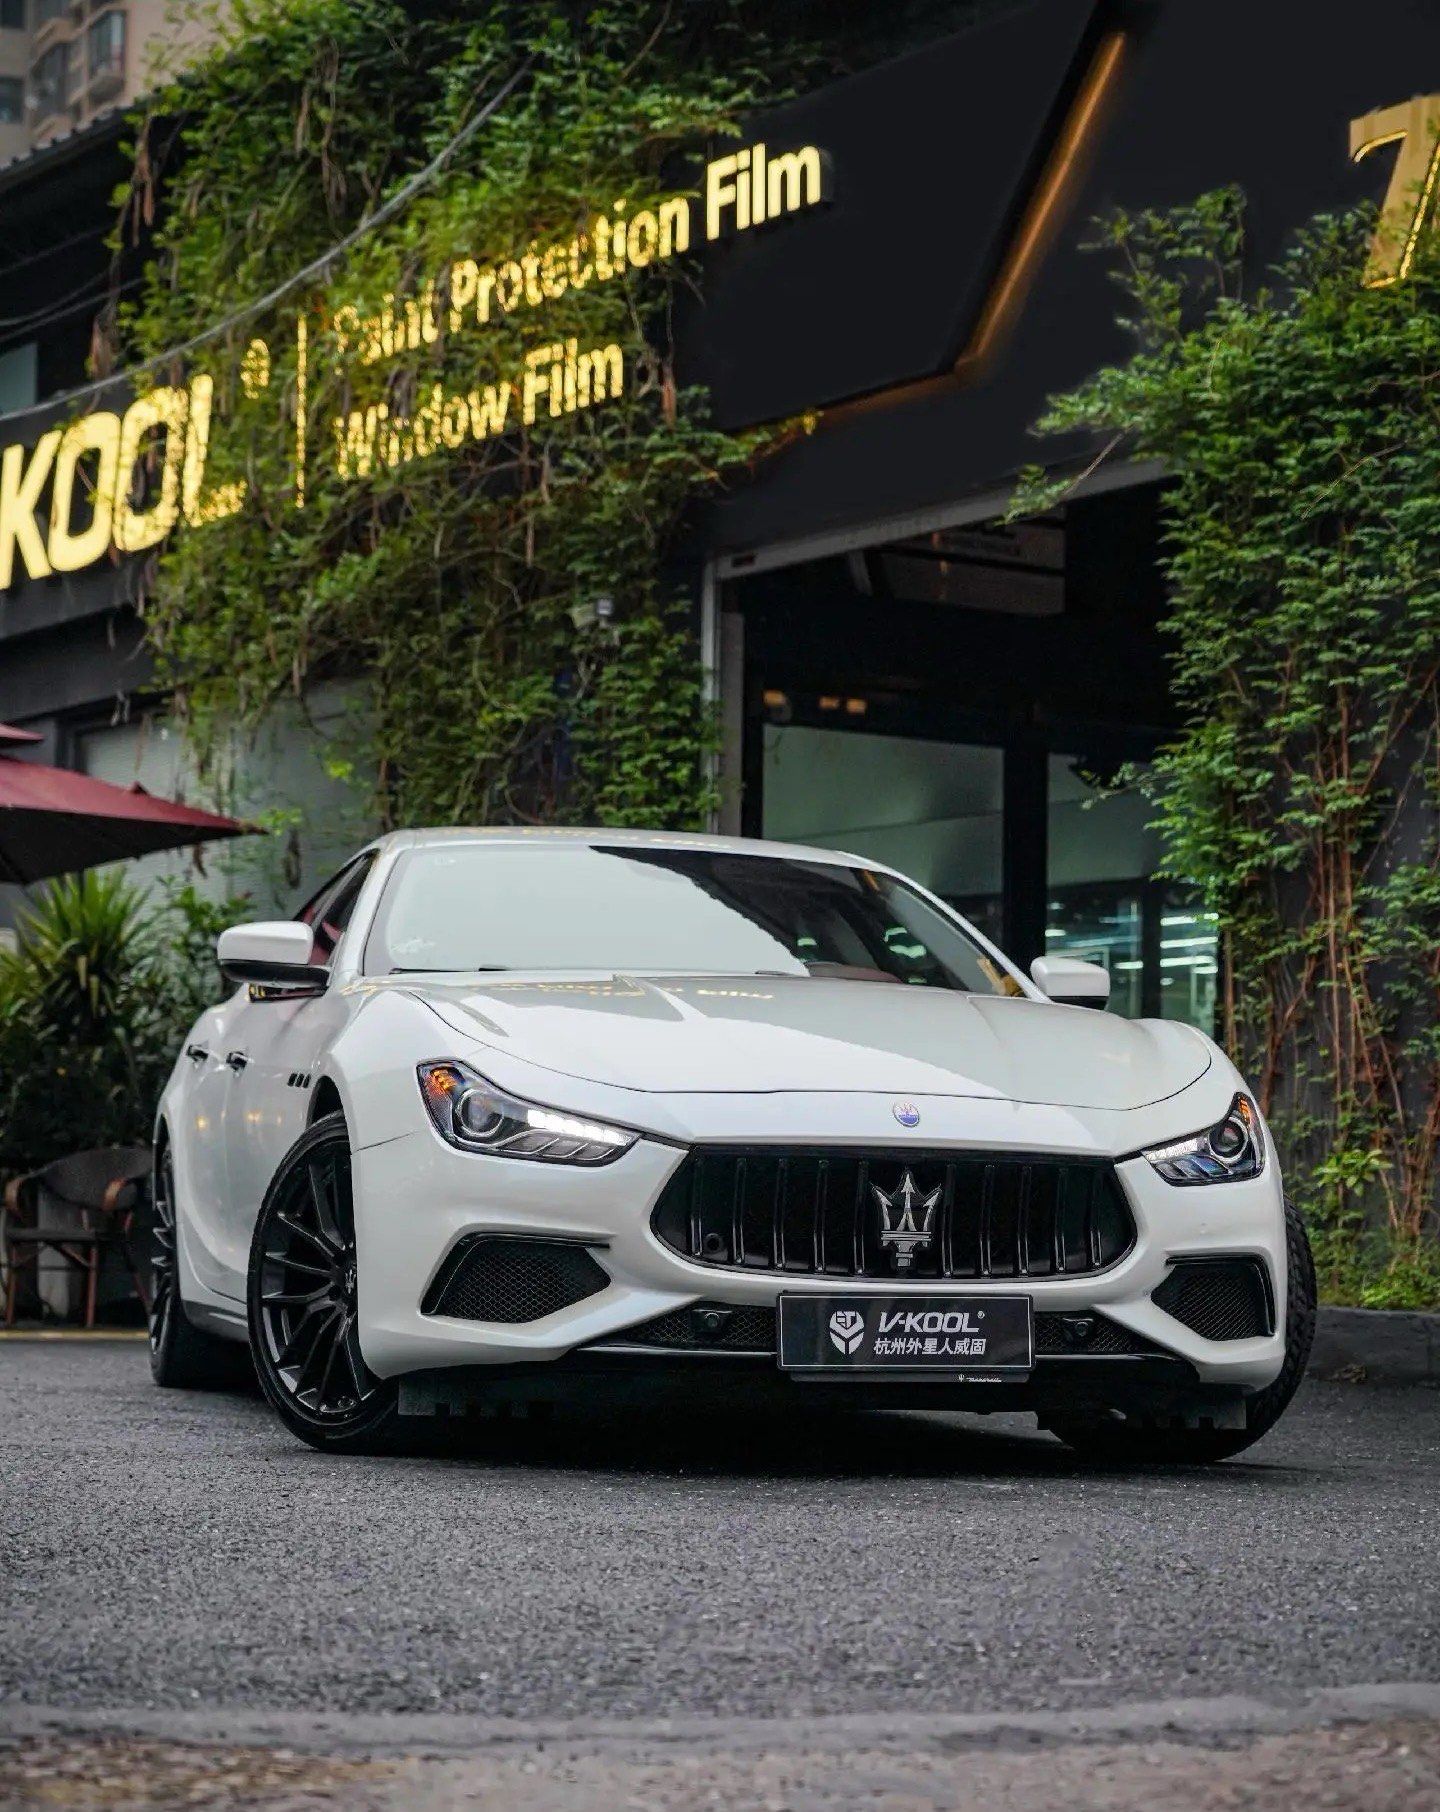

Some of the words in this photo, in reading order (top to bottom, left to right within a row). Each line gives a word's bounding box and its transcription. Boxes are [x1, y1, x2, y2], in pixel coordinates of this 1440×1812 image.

[450, 197, 690, 334] Protection
[706, 142, 822, 241] Film
[522, 337, 624, 426] Film
[873, 1337, 987, 1356] 杭州外星人威固
